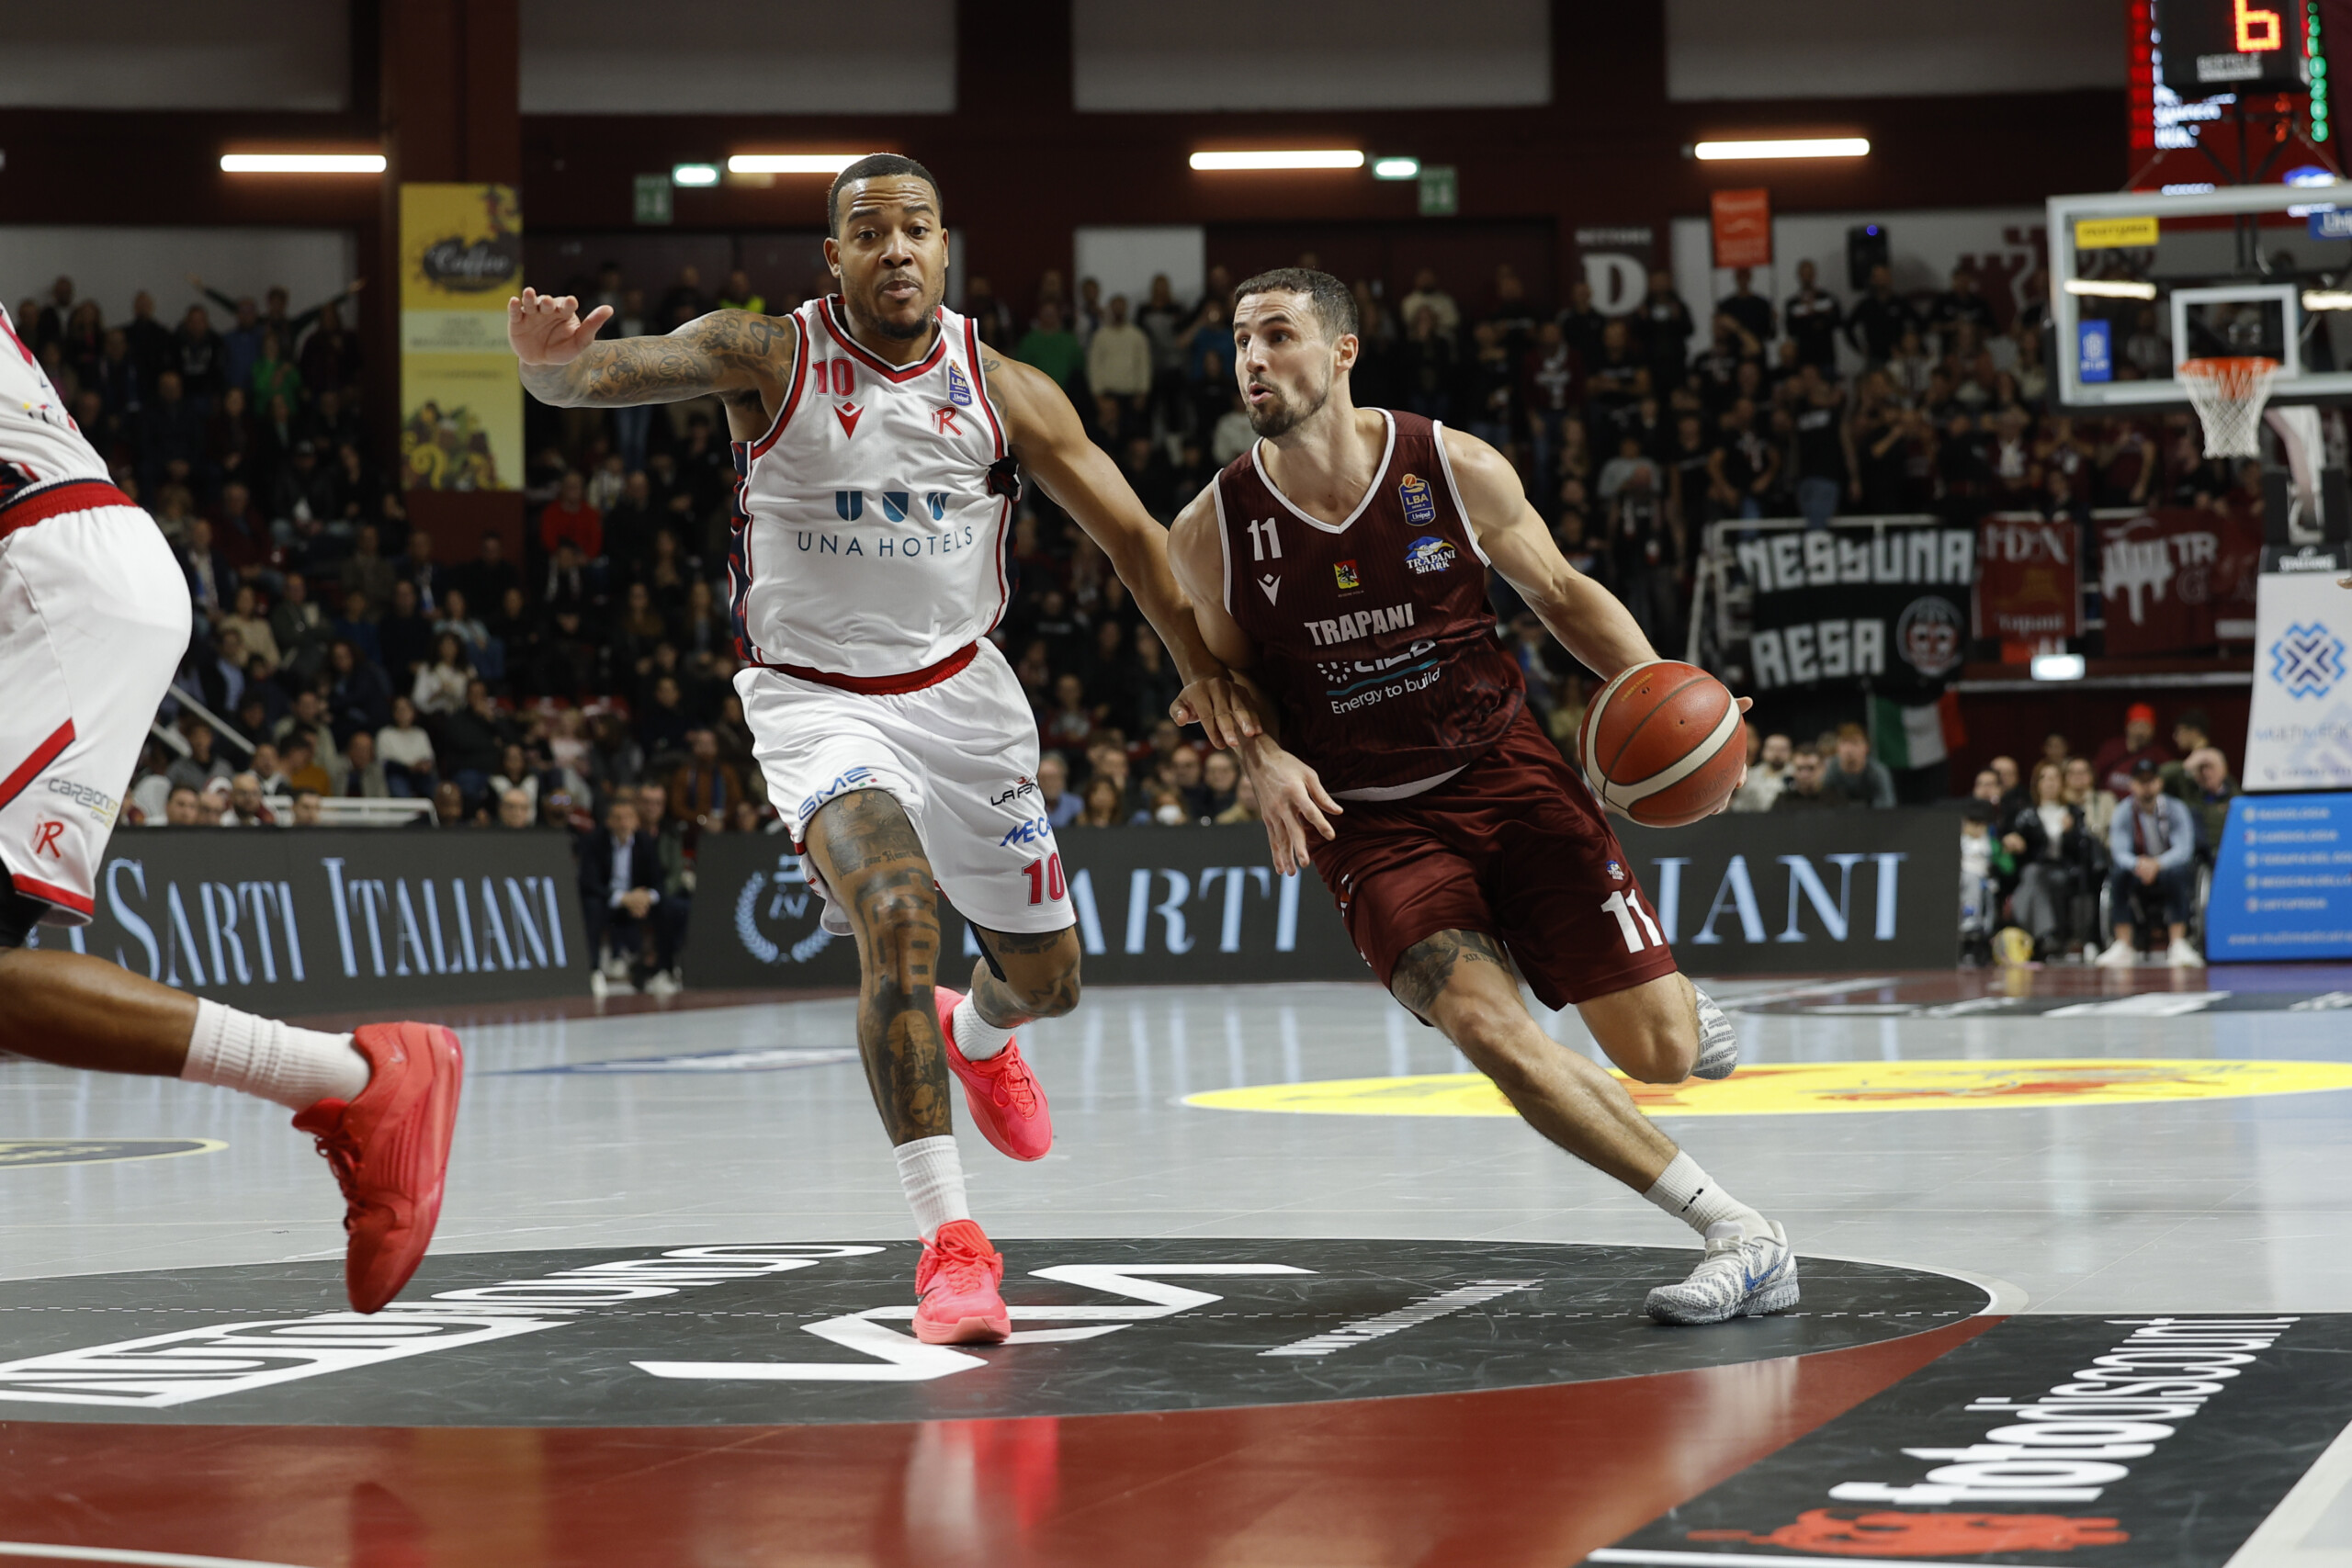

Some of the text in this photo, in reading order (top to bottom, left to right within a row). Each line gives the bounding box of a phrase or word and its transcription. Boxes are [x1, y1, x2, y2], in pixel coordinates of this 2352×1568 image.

[812, 358, 855, 396] 10
[1406, 493, 1429, 505] LBA
[797, 526, 972, 557] UNA HOTELS
[1247, 517, 1283, 561] 11
[1407, 550, 1456, 569] TRAPANI
[1416, 560, 1450, 574] SHARK
[1304, 603, 1415, 646] TRAPANI
[1331, 667, 1442, 714] Energy to build
[1022, 852, 1065, 906] 10
[106, 857, 566, 987] SARTI ITALIANI
[963, 864, 1301, 953] ARTI
[1600, 888, 1664, 953] 11
[1828, 1317, 2301, 1505] fotodiscount
